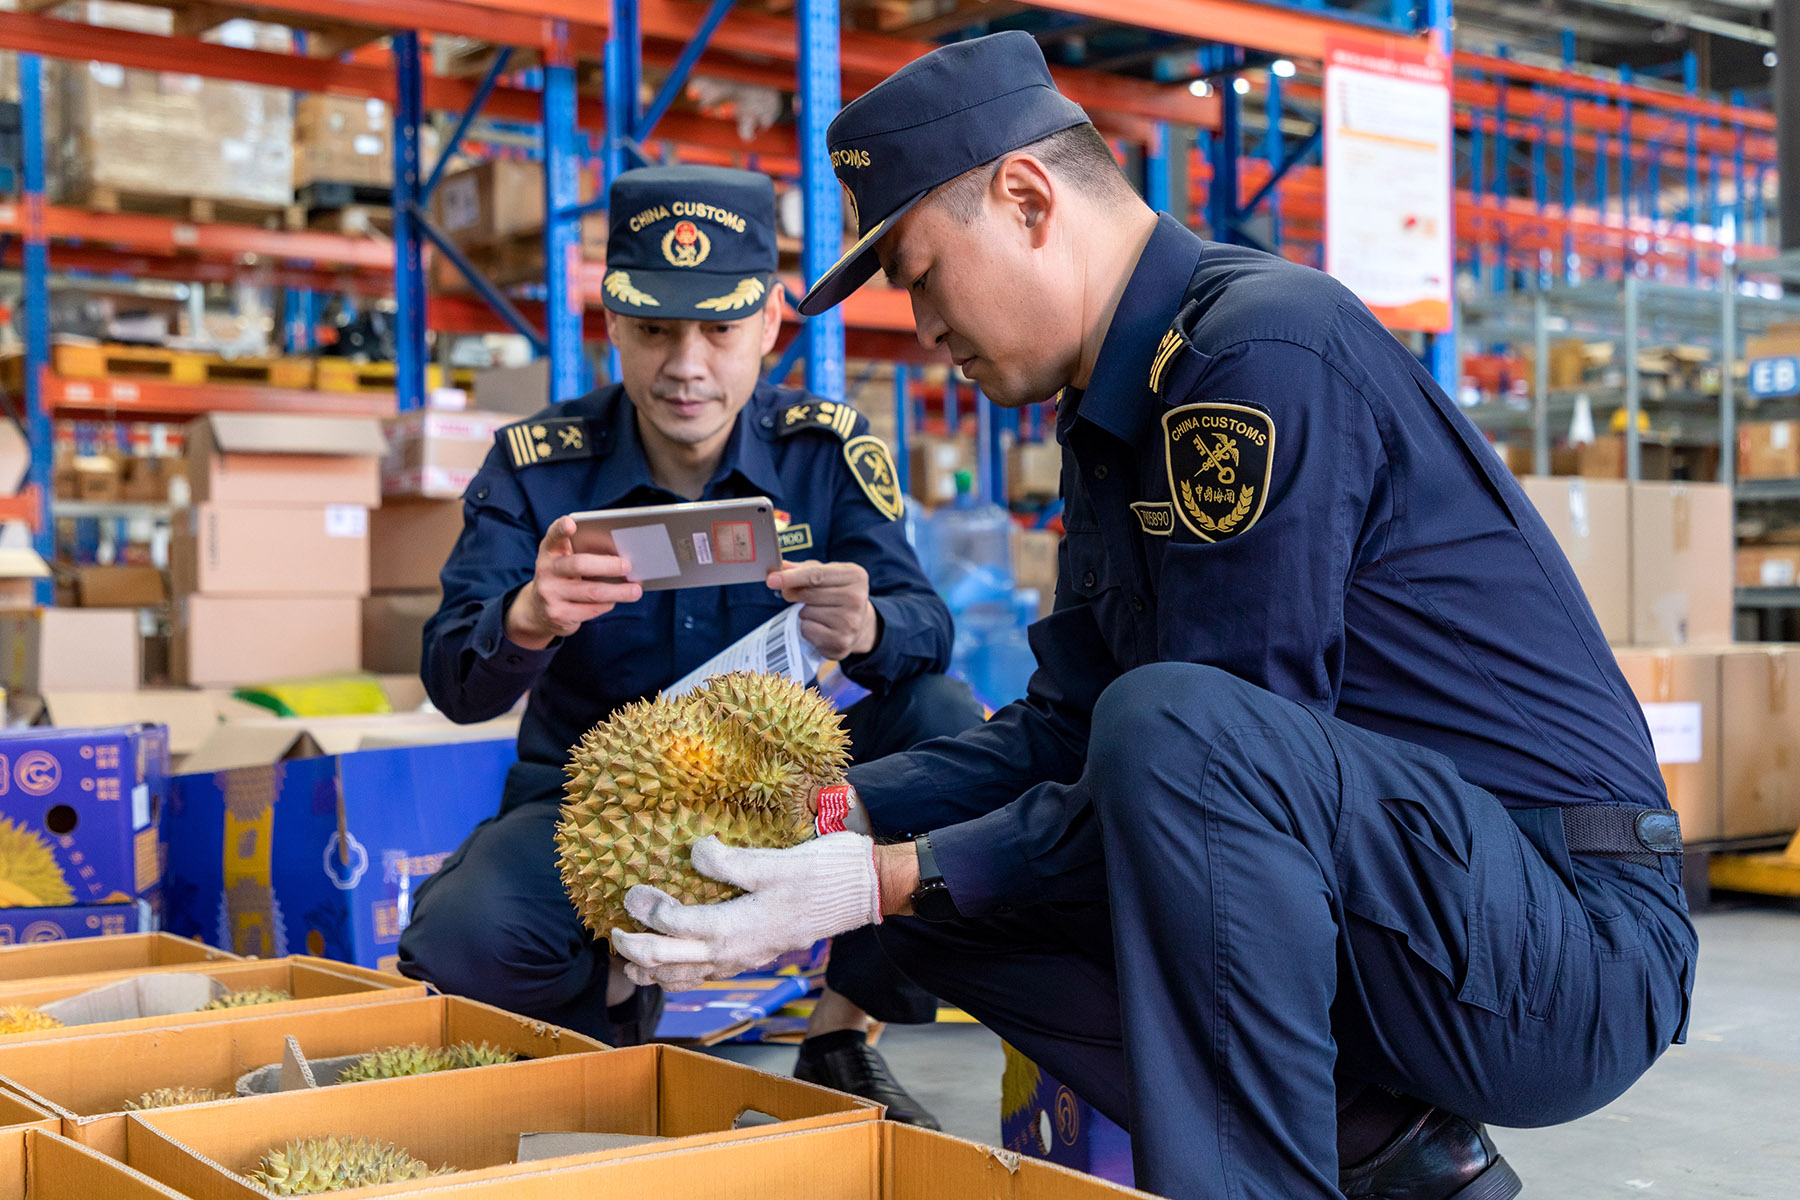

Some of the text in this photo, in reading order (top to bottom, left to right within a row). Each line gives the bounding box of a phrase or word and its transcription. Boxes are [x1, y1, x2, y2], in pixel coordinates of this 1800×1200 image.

[629, 201, 747, 233] CHINA CUSTOMS
[1171, 415, 1267, 447] CHINA CUSTOMS
